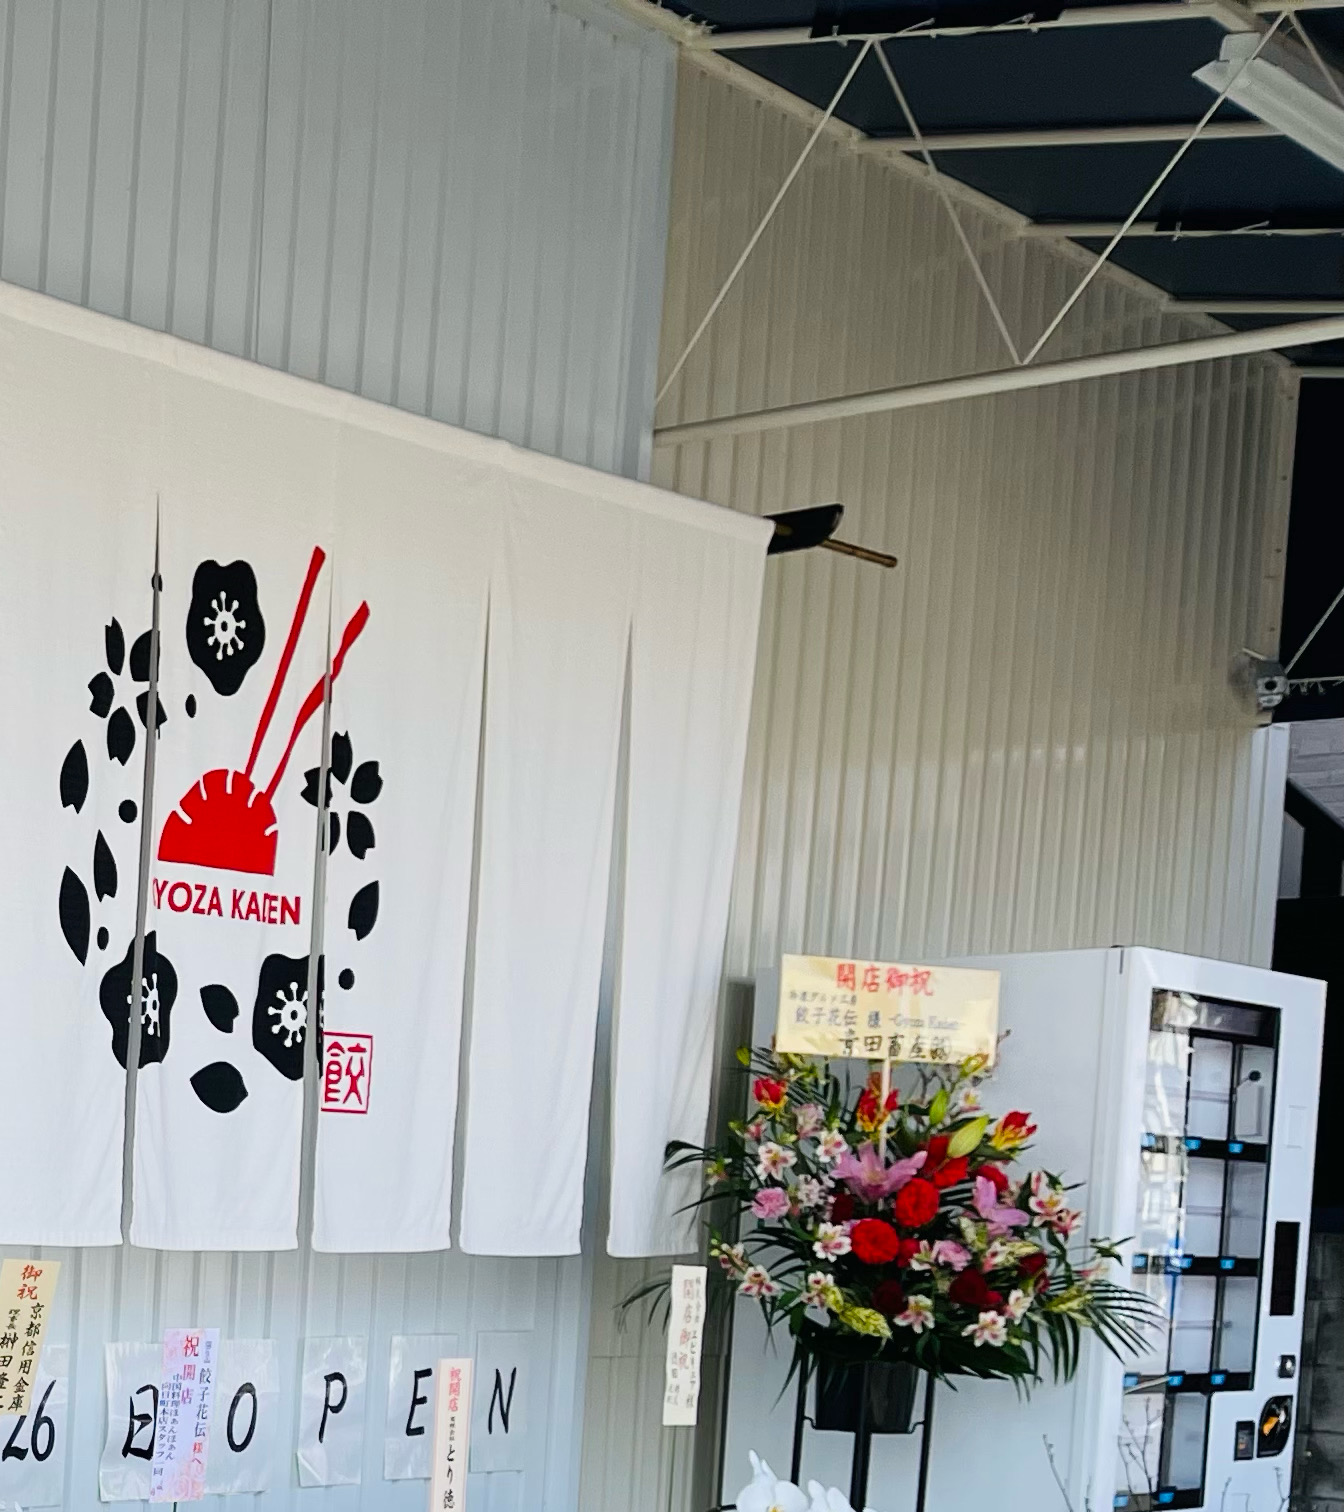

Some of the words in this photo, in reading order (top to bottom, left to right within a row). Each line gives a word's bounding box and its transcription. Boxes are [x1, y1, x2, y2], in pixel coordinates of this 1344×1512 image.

[153, 877, 223, 917] YOZA
[16, 1264, 43, 1300] 御祝
[7, 1302, 45, 1412] 京都信用金庫
[181, 1334, 200, 1406] 祝開店
[194, 1368, 213, 1438] 餃子花伝
